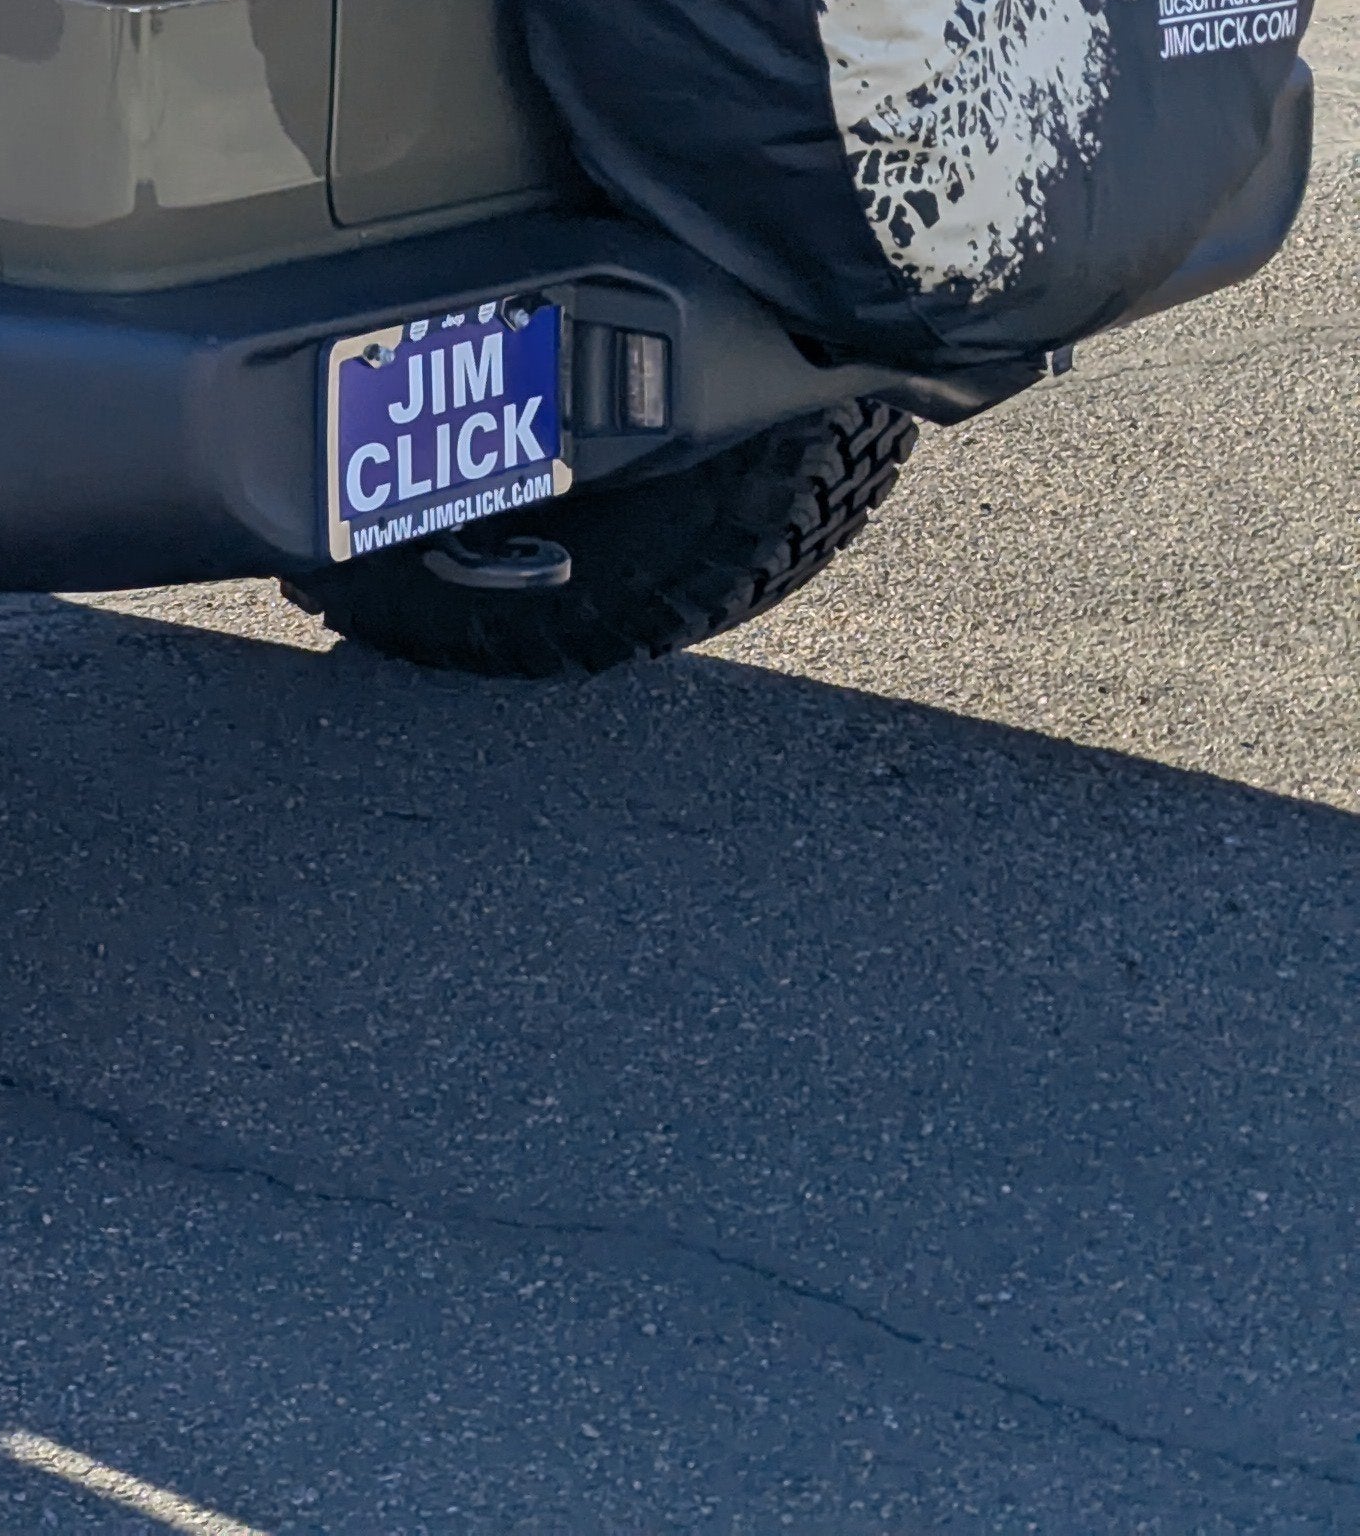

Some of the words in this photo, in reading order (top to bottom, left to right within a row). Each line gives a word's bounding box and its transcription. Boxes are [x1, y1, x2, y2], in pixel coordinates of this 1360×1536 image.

[1160, 8, 1298, 59] JIMCLICK.COM
[388, 332, 504, 424] JIM
[346, 396, 546, 513] CLICK
[353, 473, 552, 554] WWW.JIMCLICK.COM
